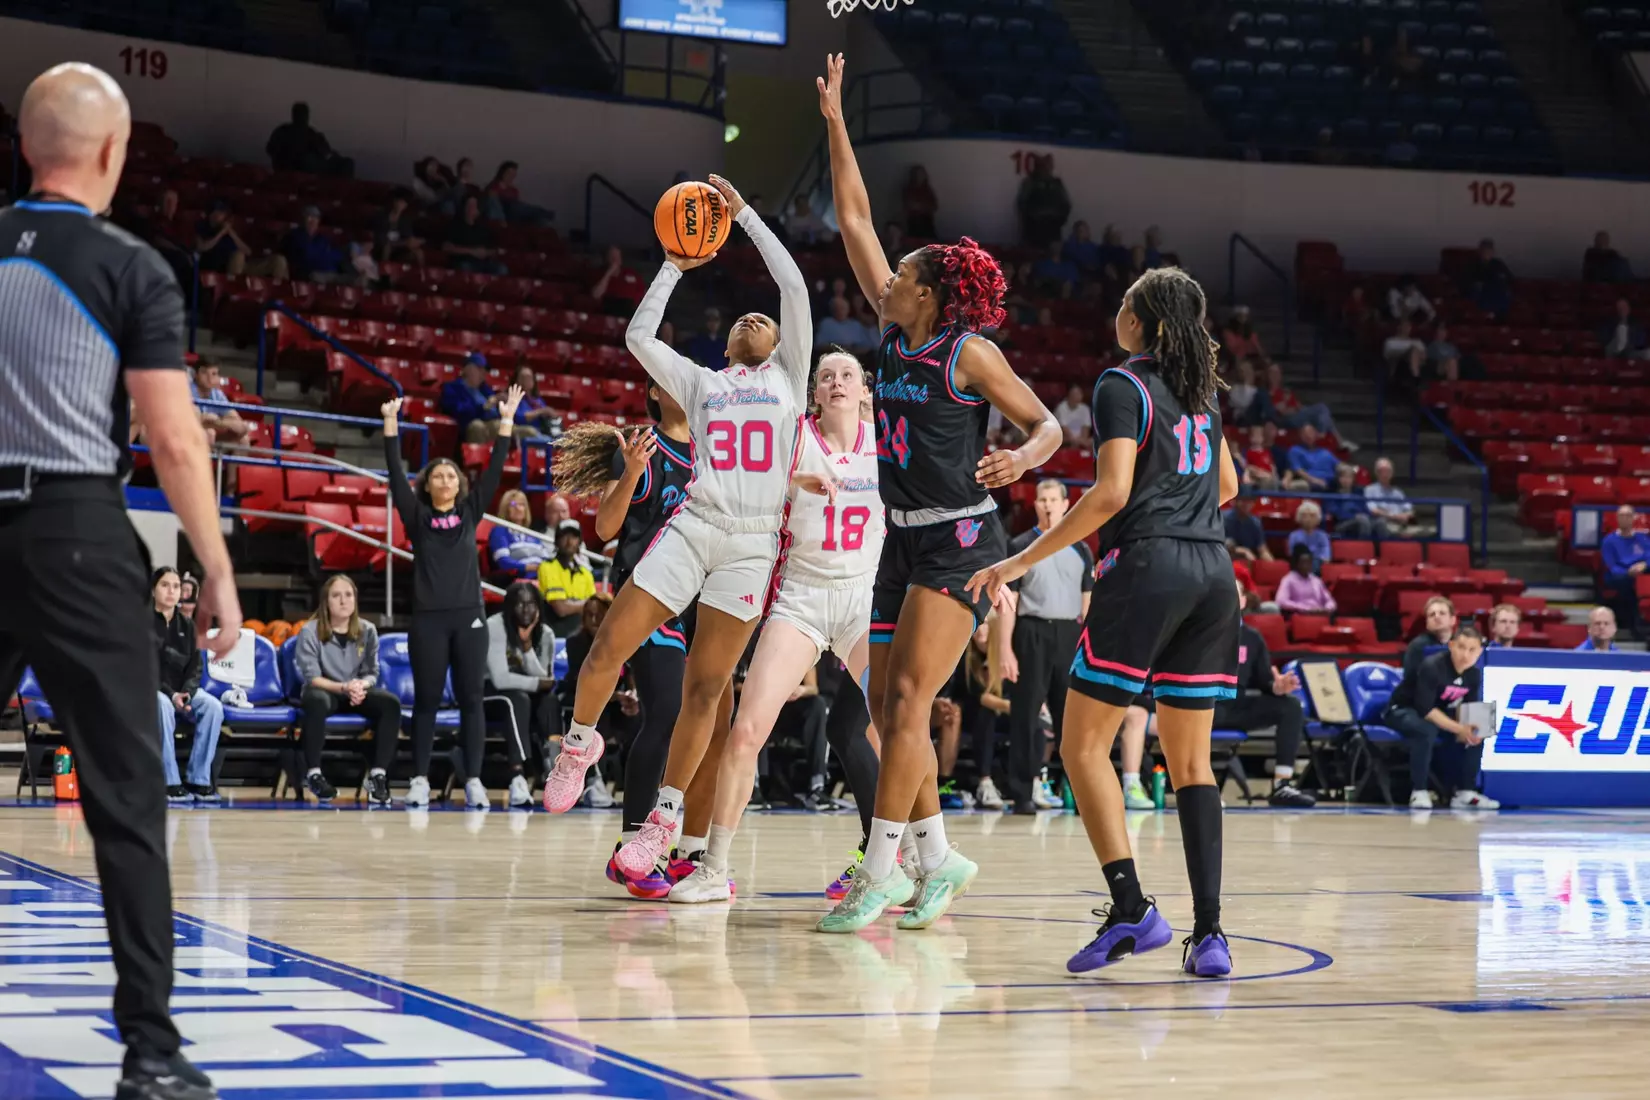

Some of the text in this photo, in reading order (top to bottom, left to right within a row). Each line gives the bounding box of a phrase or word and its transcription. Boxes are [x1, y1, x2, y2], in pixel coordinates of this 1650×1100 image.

[118, 46, 168, 80] 119
[1009, 149, 1055, 178] 10
[685, 197, 697, 236] NCAA
[706, 192, 723, 243] Wilson
[1467, 180, 1516, 208] 102
[706, 420, 774, 473] 30
[876, 408, 912, 470] 24
[1173, 412, 1212, 475] 15
[821, 505, 871, 552] 18
